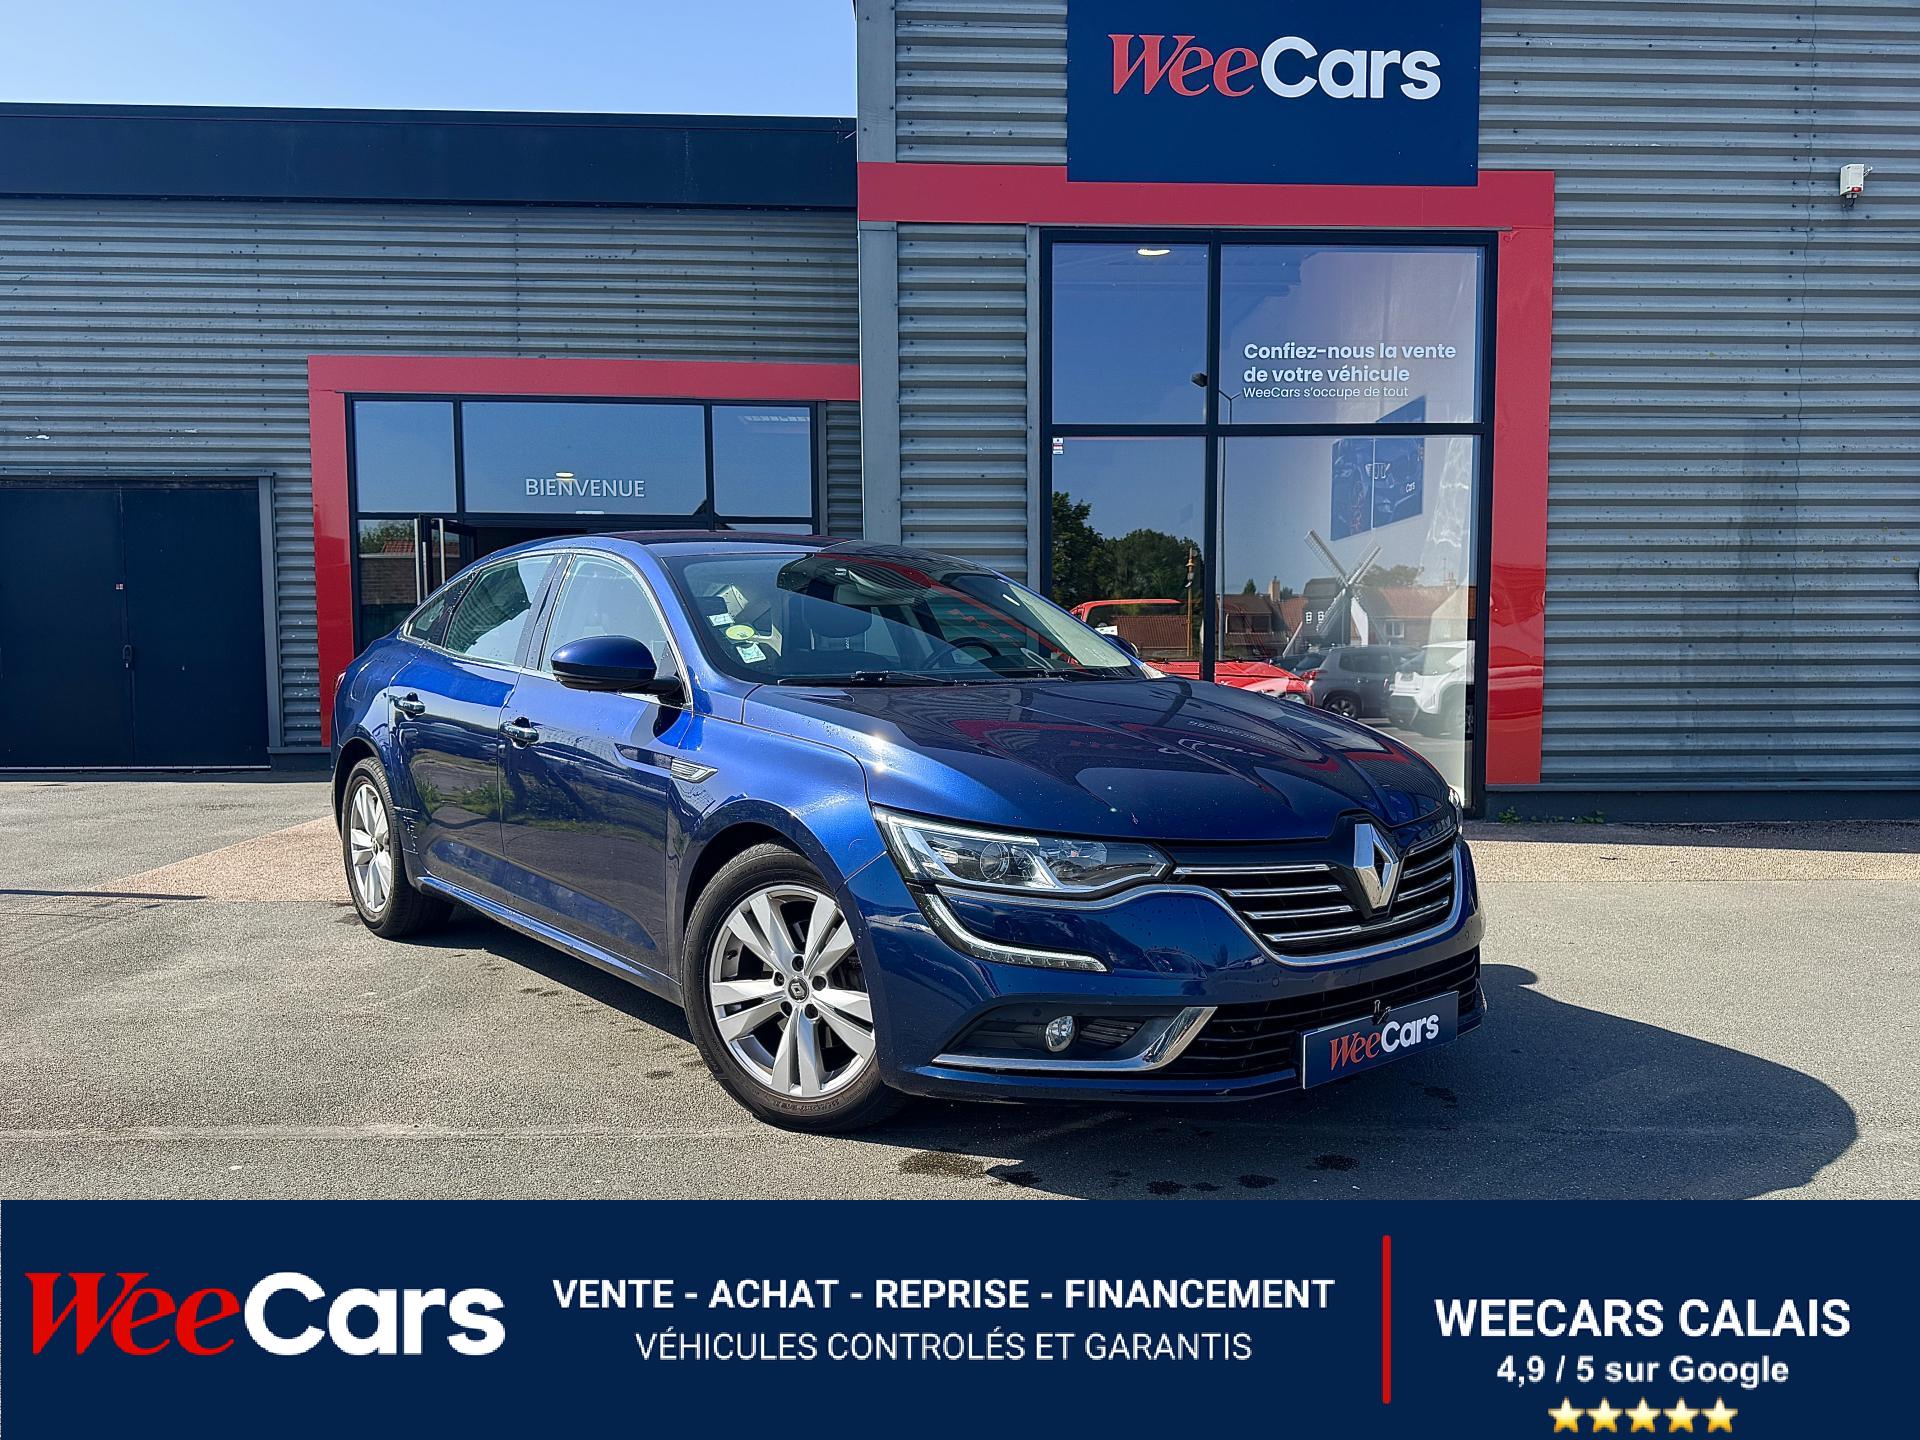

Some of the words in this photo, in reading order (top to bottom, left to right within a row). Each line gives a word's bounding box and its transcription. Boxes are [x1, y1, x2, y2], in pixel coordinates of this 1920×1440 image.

[1108, 34, 1441, 100] WeeCars
[1244, 342, 1375, 359] Confiez-nous
[1379, 343, 1397, 359] la
[1402, 343, 1457, 359] vente
[1243, 367, 1268, 383] de
[1272, 369, 1323, 382] votre
[1327, 364, 1410, 382] véhicule
[1243, 387, 1300, 398] WeeCars
[1363, 386, 1380, 397] de
[1383, 386, 1409, 397] tout
[525, 479, 645, 497] BIENVENUE
[1329, 1014, 1440, 1071] WeeCars
